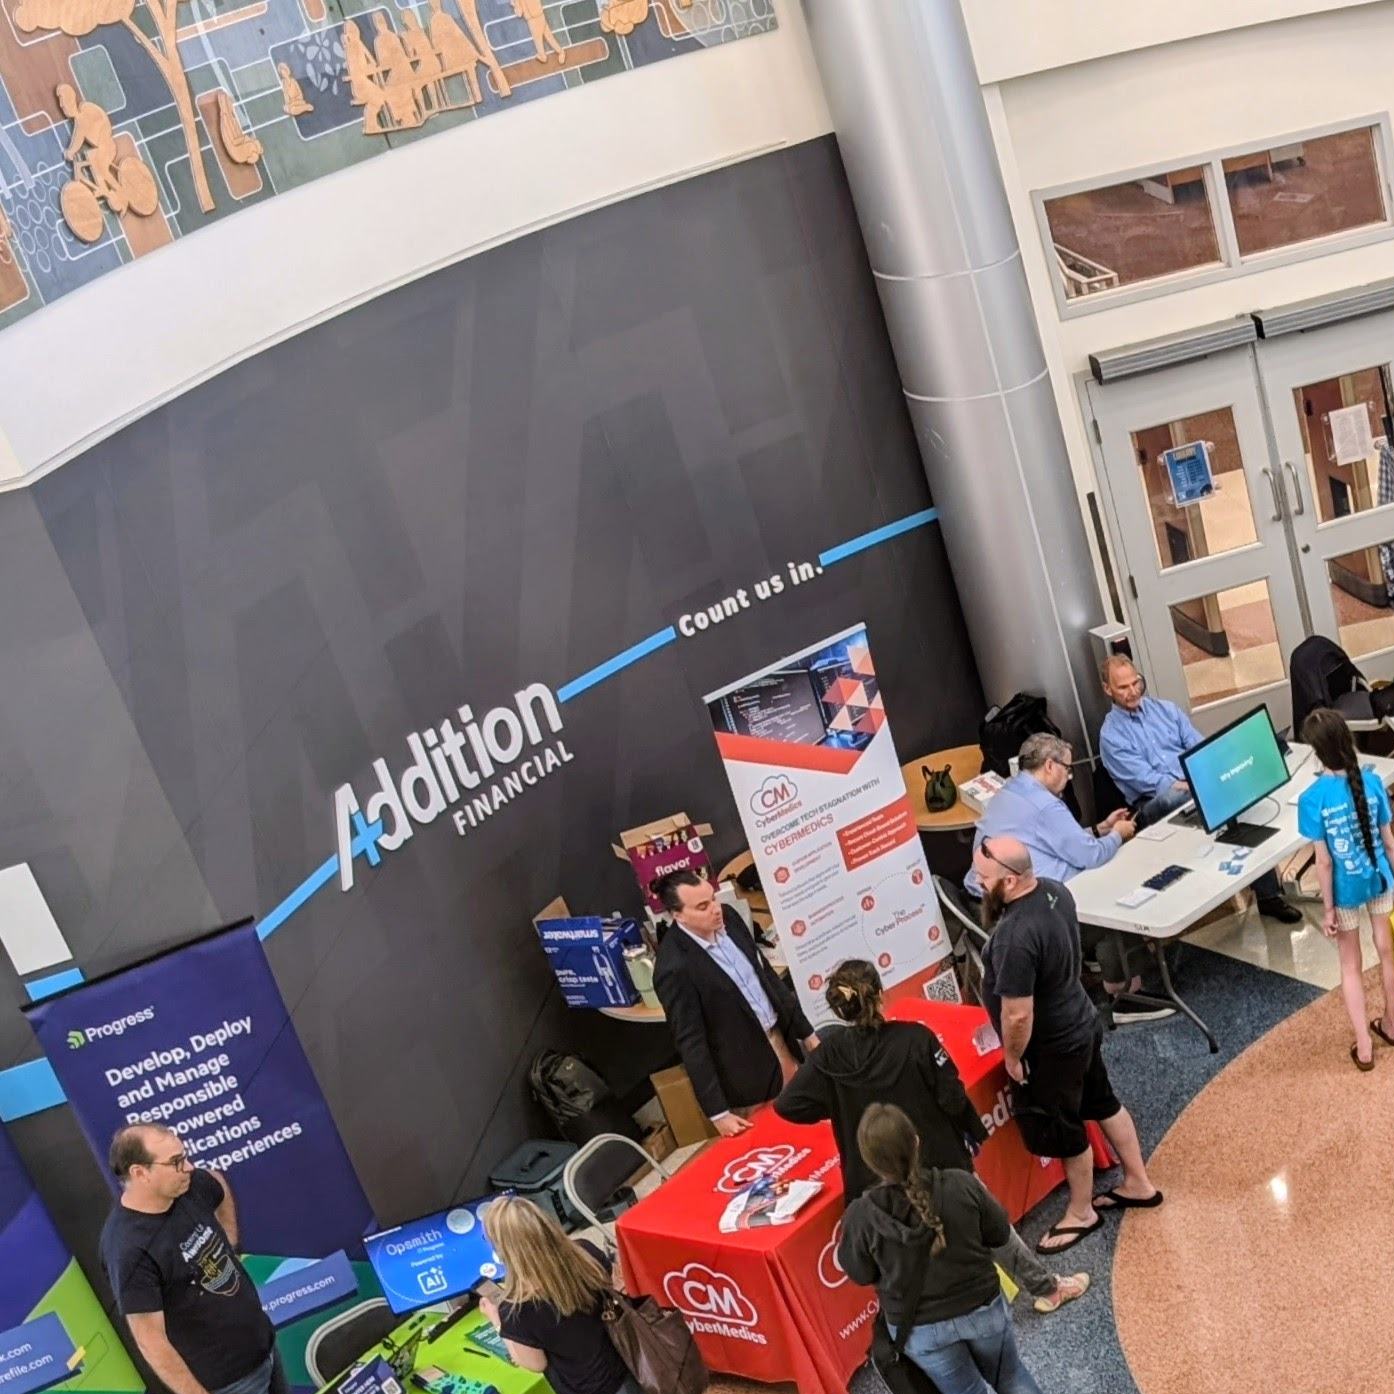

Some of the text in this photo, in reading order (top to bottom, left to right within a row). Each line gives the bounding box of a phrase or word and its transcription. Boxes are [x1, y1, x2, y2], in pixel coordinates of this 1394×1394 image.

[678, 560, 824, 638] Count us in.
[334, 681, 564, 892] Addition
[452, 740, 575, 836] FINANCIAL
[761, 783, 790, 809] CM
[755, 800, 803, 829] CyberMedics
[760, 777, 881, 844] OVERCOME TECH STAGNATION WITH
[764, 813, 834, 857] CYBERMEDICS
[655, 856, 691, 877] flavor
[543, 928, 599, 941] smartwater
[875, 920, 896, 937] Cyber
[85, 1006, 155, 1043] Progress
[104, 1015, 252, 1087] Develop, Deploy
[117, 1051, 231, 1109] and Manage
[126, 1073, 238, 1125] Responsible
[166, 1093, 245, 1137] powered
[183, 1114, 262, 1158] lications
[194, 1119, 302, 1172] Experiences
[732, 1152, 785, 1183] CM
[385, 1229, 442, 1256] Opsmith
[426, 1273, 441, 1289] AI
[683, 1280, 743, 1318] CM
[685, 1317, 768, 1345] yberMedics
[839, 1298, 880, 1340] www.Cy
